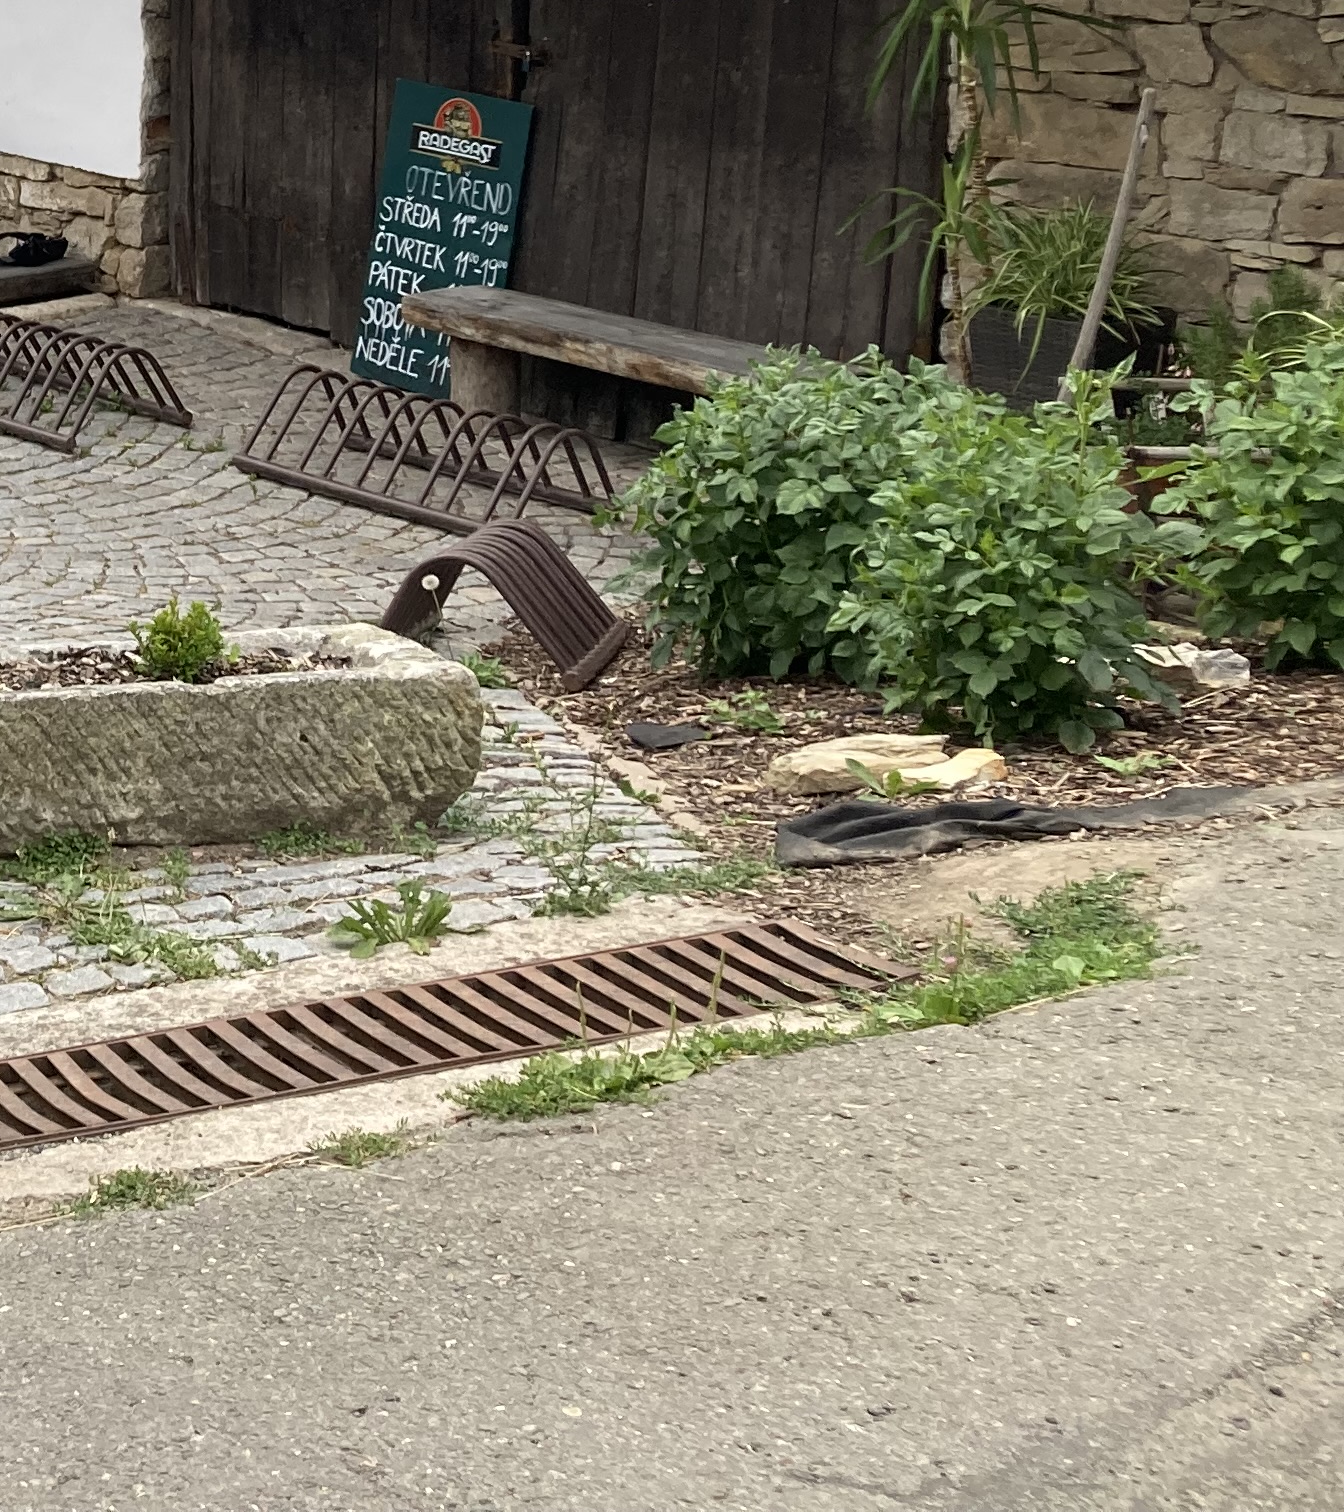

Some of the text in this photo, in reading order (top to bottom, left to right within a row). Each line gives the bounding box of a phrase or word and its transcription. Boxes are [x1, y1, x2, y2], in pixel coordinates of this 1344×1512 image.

[418, 130, 497, 164] RADEGAST
[405, 165, 513, 216] OTEVŘENO
[379, 196, 442, 232] STŘEDA
[374, 224, 447, 273] ČTVRTEK
[368, 260, 426, 297] PÁTEK
[355, 335, 425, 379] NEDĚLE
